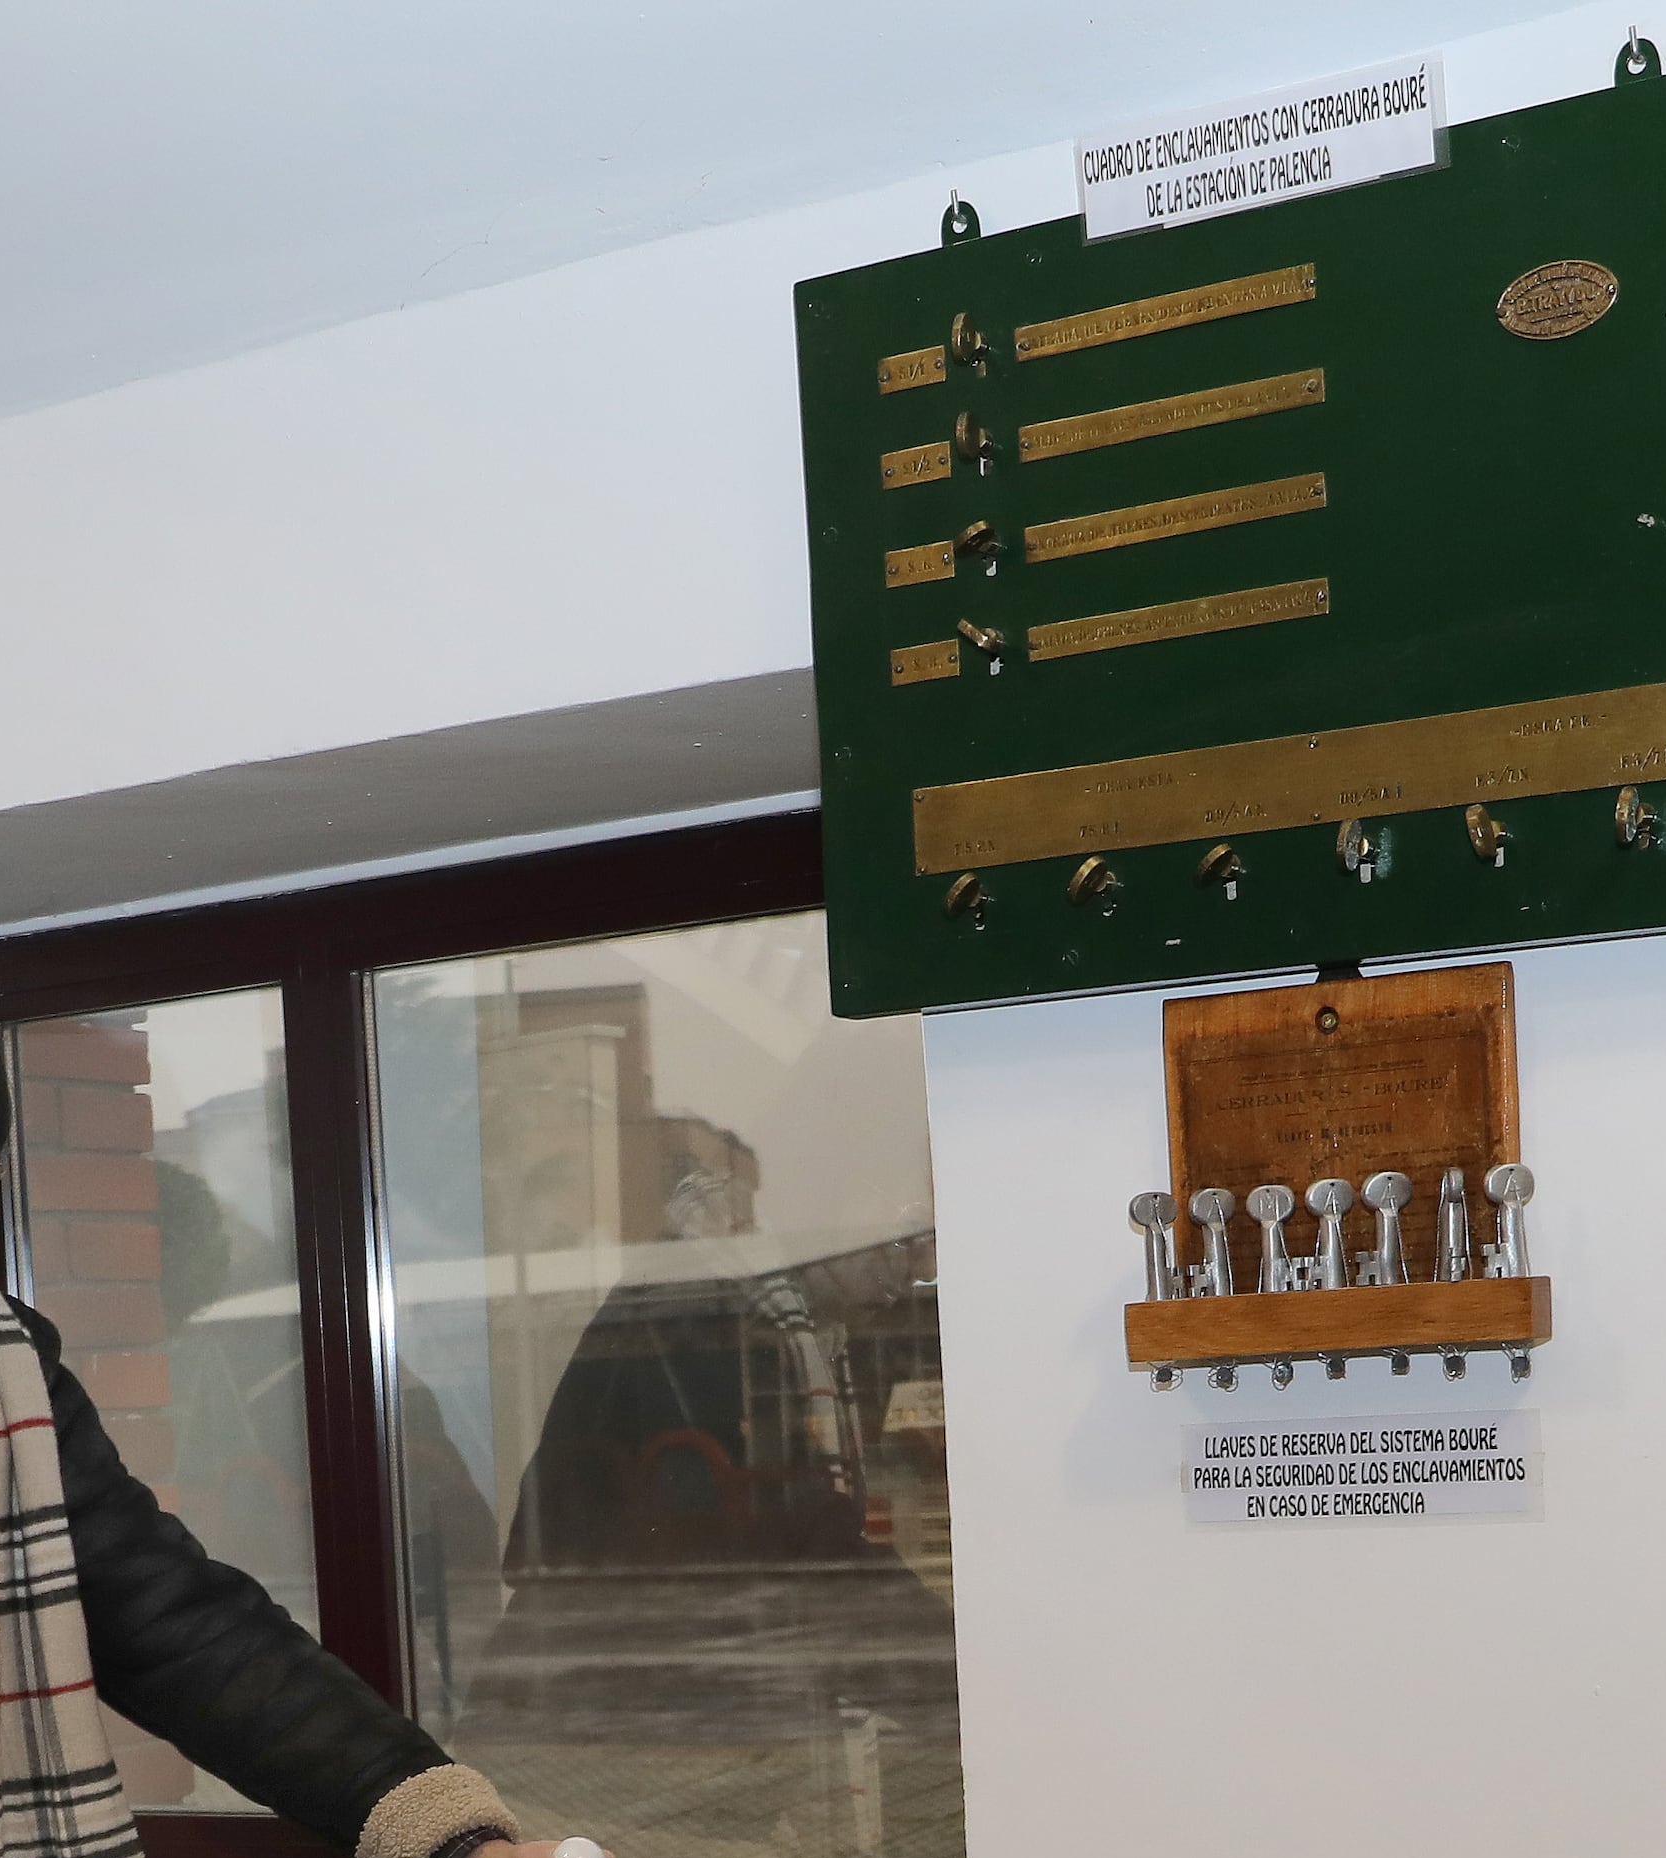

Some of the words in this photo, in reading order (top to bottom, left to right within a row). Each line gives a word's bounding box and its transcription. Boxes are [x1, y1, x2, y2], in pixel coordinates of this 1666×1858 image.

[1084, 142, 1133, 185] CUADRO
[1136, 137, 1153, 172] DE
[1156, 110, 1269, 168] ENCLAVAMIENTOS
[1272, 103, 1299, 140] CON
[1302, 84, 1380, 134] CERRADURA
[1383, 63, 1427, 117] BOURÉ
[1147, 185, 1164, 218] DE
[1167, 180, 1183, 215] LA
[1187, 159, 1246, 209] ESTACIÓN
[1249, 159, 1266, 195] DE
[1269, 146, 1332, 191] PALENCIA
[1205, 1437, 1256, 1459] LLAVES
[1260, 1435, 1278, 1457] DE
[1282, 1433, 1346, 1456] RESERVA
[1350, 1432, 1377, 1454] DEL
[1380, 1430, 1444, 1452] SISTEMA
[1450, 1423, 1498, 1450] BOURÉ
[1194, 1467, 1230, 1489] PARA
[1235, 1467, 1251, 1487] LA
[1256, 1463, 1334, 1487] SEGURIDAD
[1339, 1463, 1357, 1484] DE
[1361, 1462, 1388, 1484] LOS
[1393, 1458, 1525, 1483] ENCLAVAMIENTOS
[1248, 1496, 1265, 1517] EN
[1270, 1495, 1307, 1517] CASO
[1312, 1494, 1329, 1516] DE
[1334, 1492, 1424, 1515] EMERGENCIA
